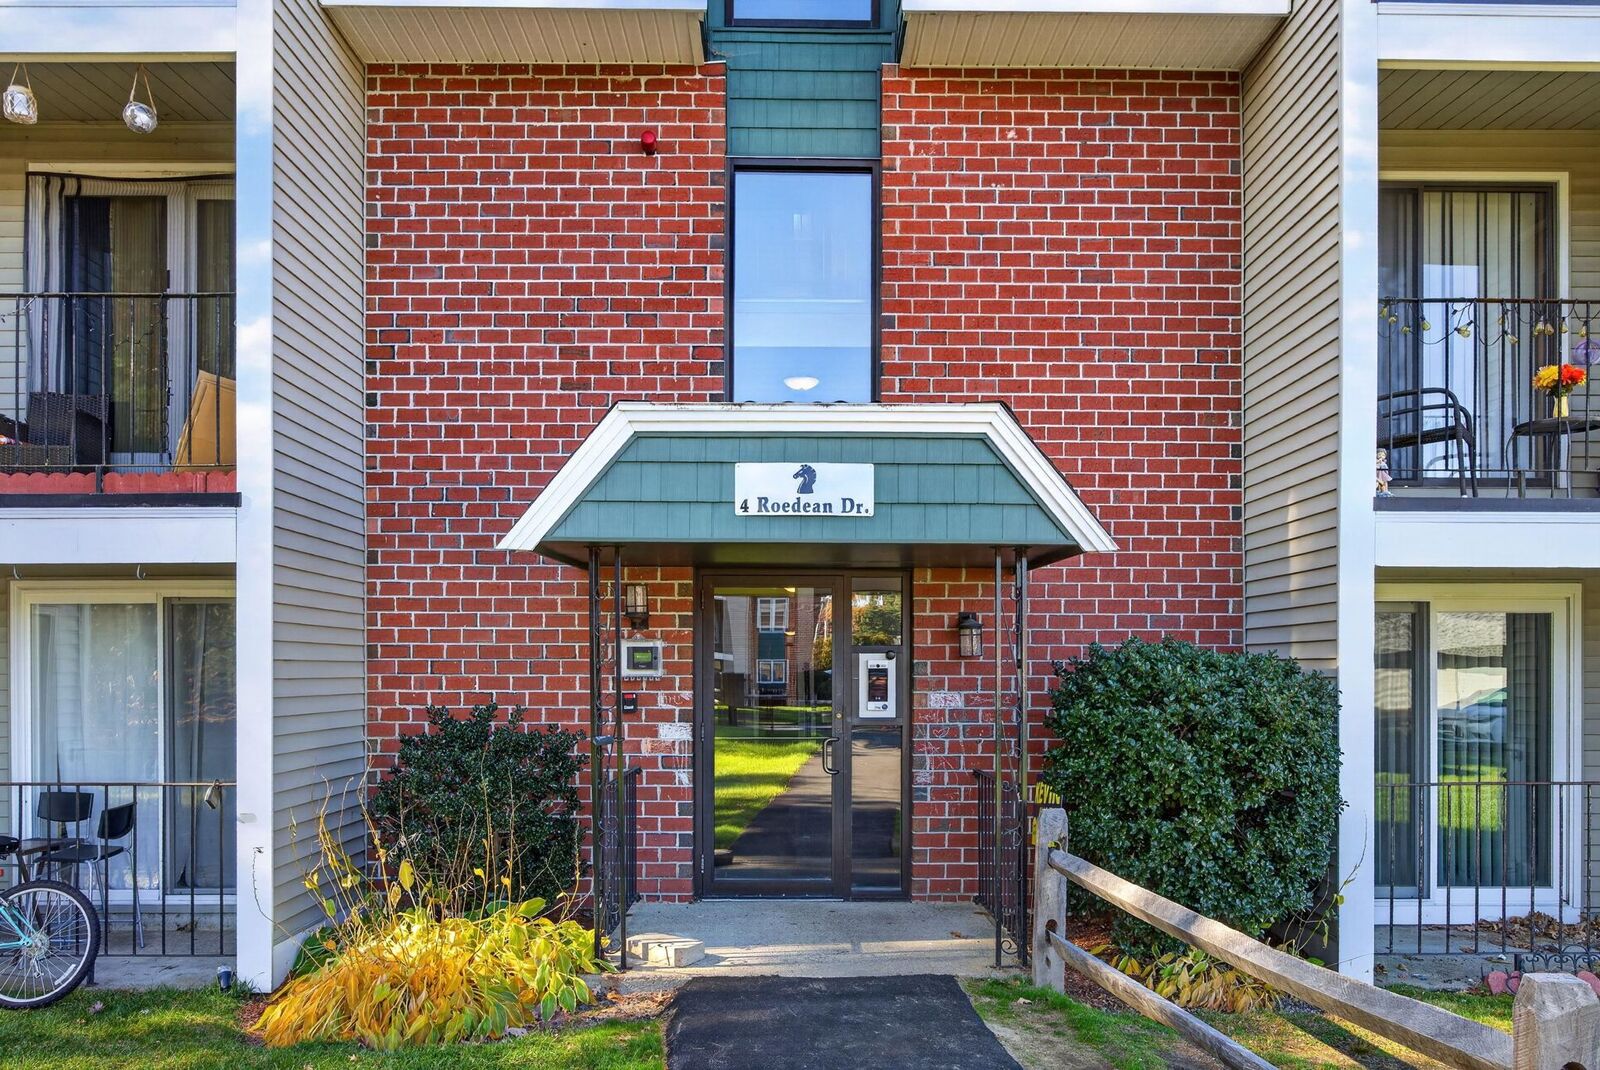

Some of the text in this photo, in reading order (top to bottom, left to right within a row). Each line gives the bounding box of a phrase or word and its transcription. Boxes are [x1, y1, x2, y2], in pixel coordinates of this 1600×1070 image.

[740, 496, 869, 514] 4 Roedean Dr.
